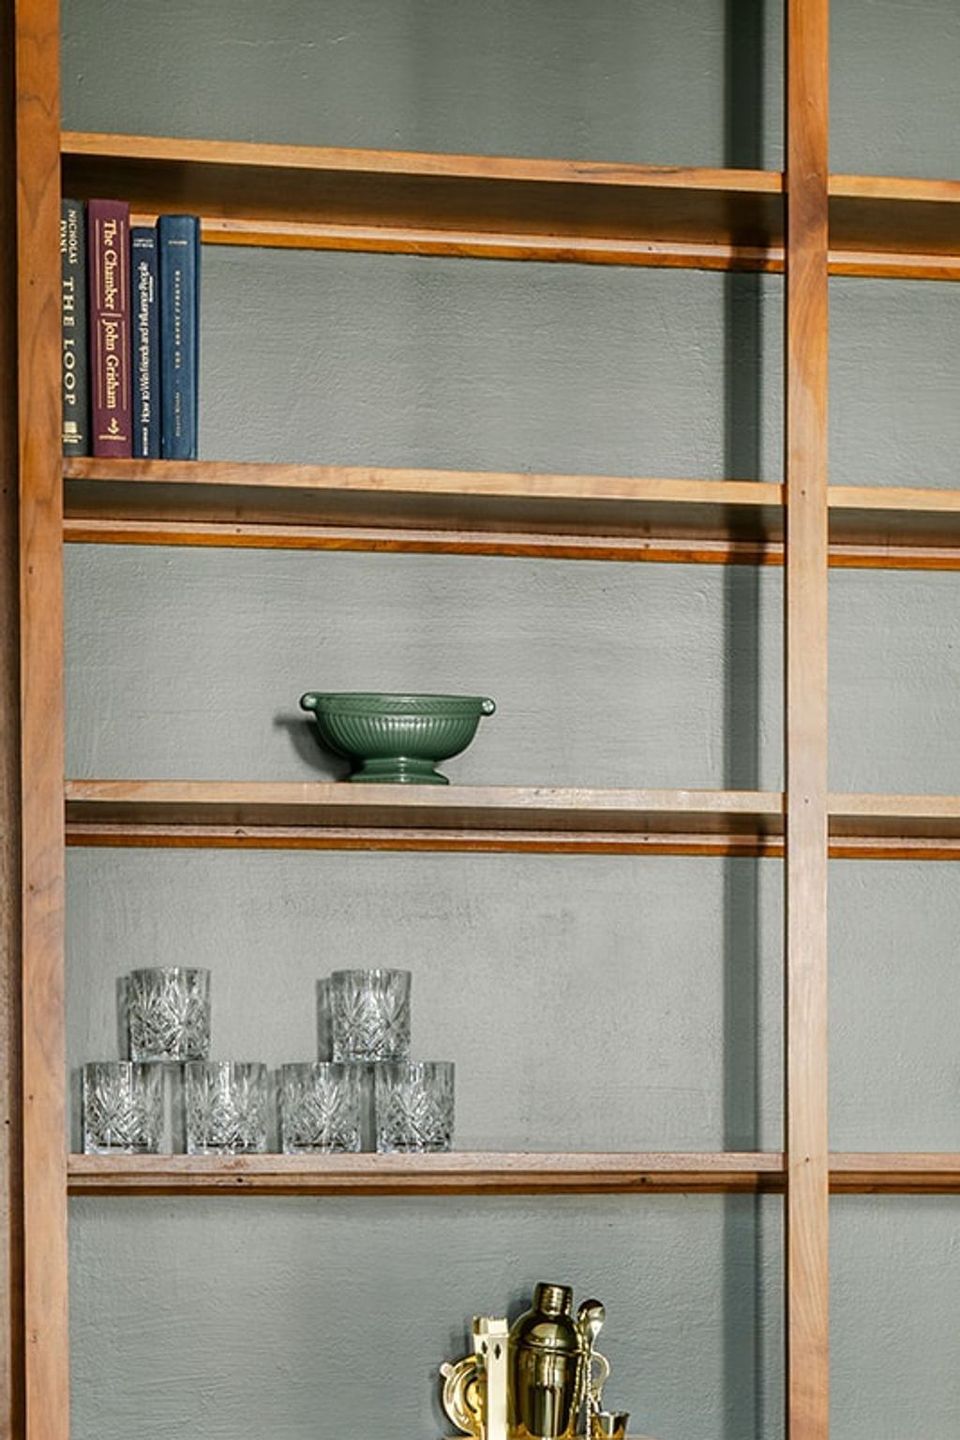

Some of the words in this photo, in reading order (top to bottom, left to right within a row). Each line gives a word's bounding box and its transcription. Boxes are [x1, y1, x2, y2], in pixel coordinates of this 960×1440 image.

[68, 209, 79, 265] NICHOLAS
[103, 219, 118, 247] The
[63, 276, 77, 327] THE
[103, 249, 119, 312] Chamber
[102, 319, 120, 352] John
[64, 339, 77, 405] LOOP
[107, 354, 121, 410] Grisham
